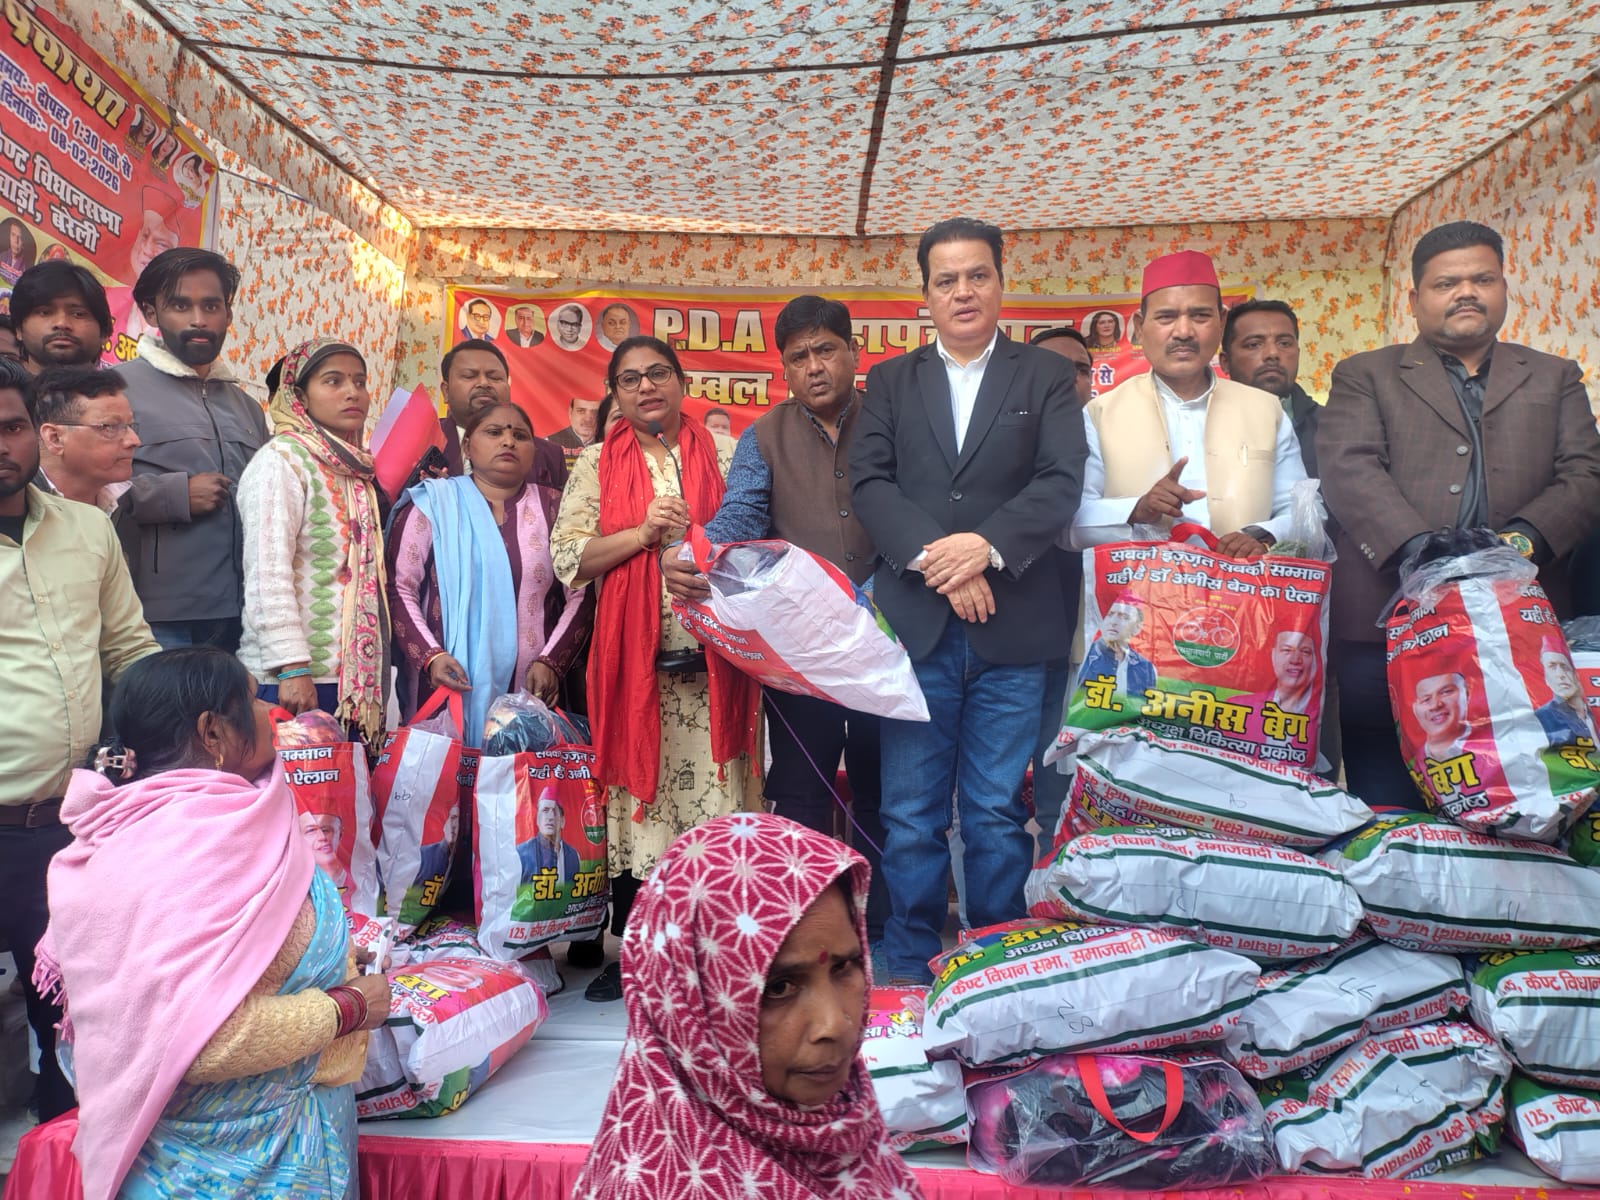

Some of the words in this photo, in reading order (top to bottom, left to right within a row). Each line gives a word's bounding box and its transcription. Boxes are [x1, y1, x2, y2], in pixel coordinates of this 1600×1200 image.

[0, 54, 33, 90] मय:-
[74, 119, 99, 149] 1:30
[51, 125, 119, 193] 08-02-2026
[33, 152, 122, 237] विधानसभा
[50, 203, 100, 254] बरेली
[653, 307, 767, 353] P.D.A
[684, 371, 773, 405] म्बल
[1110, 546, 1156, 563] सबको
[1218, 557, 1266, 576] सबको
[1269, 563, 1326, 583] सम्मान
[1172, 571, 1222, 591] अनीस
[1226, 578, 1256, 596] बेग
[1260, 585, 1281, 599] का
[1084, 674, 1123, 713] डॉ.
[1141, 687, 1251, 733] अनीस
[1261, 700, 1310, 744] बेग
[1188, 726, 1255, 755] चिकित्सा
[1258, 743, 1307, 764] प्रकोष्ठ
[293, 768, 340, 786] ऐलान
[529, 764, 550, 779] यही
[1425, 753, 1481, 795] बेग
[1135, 798, 1206, 827] समाजवादी
[1196, 840, 1273, 860] समाजवादी
[1420, 822, 1463, 845] विधान
[532, 866, 562, 901] डॉ.
[509, 927, 528, 940] 125,
[1236, 937, 1282, 957] विधान
[1432, 926, 1513, 946] समाजवादी
[985, 964, 1030, 985] विधान
[1033, 954, 1069, 975] सभा,
[1072, 934, 1147, 964] समाजवादी
[1523, 970, 1561, 992] कैण्ट
[1376, 1010, 1411, 1028] सभा,
[1523, 1107, 1555, 1128] 125,
[1553, 1093, 1592, 1115] कैण्ट
